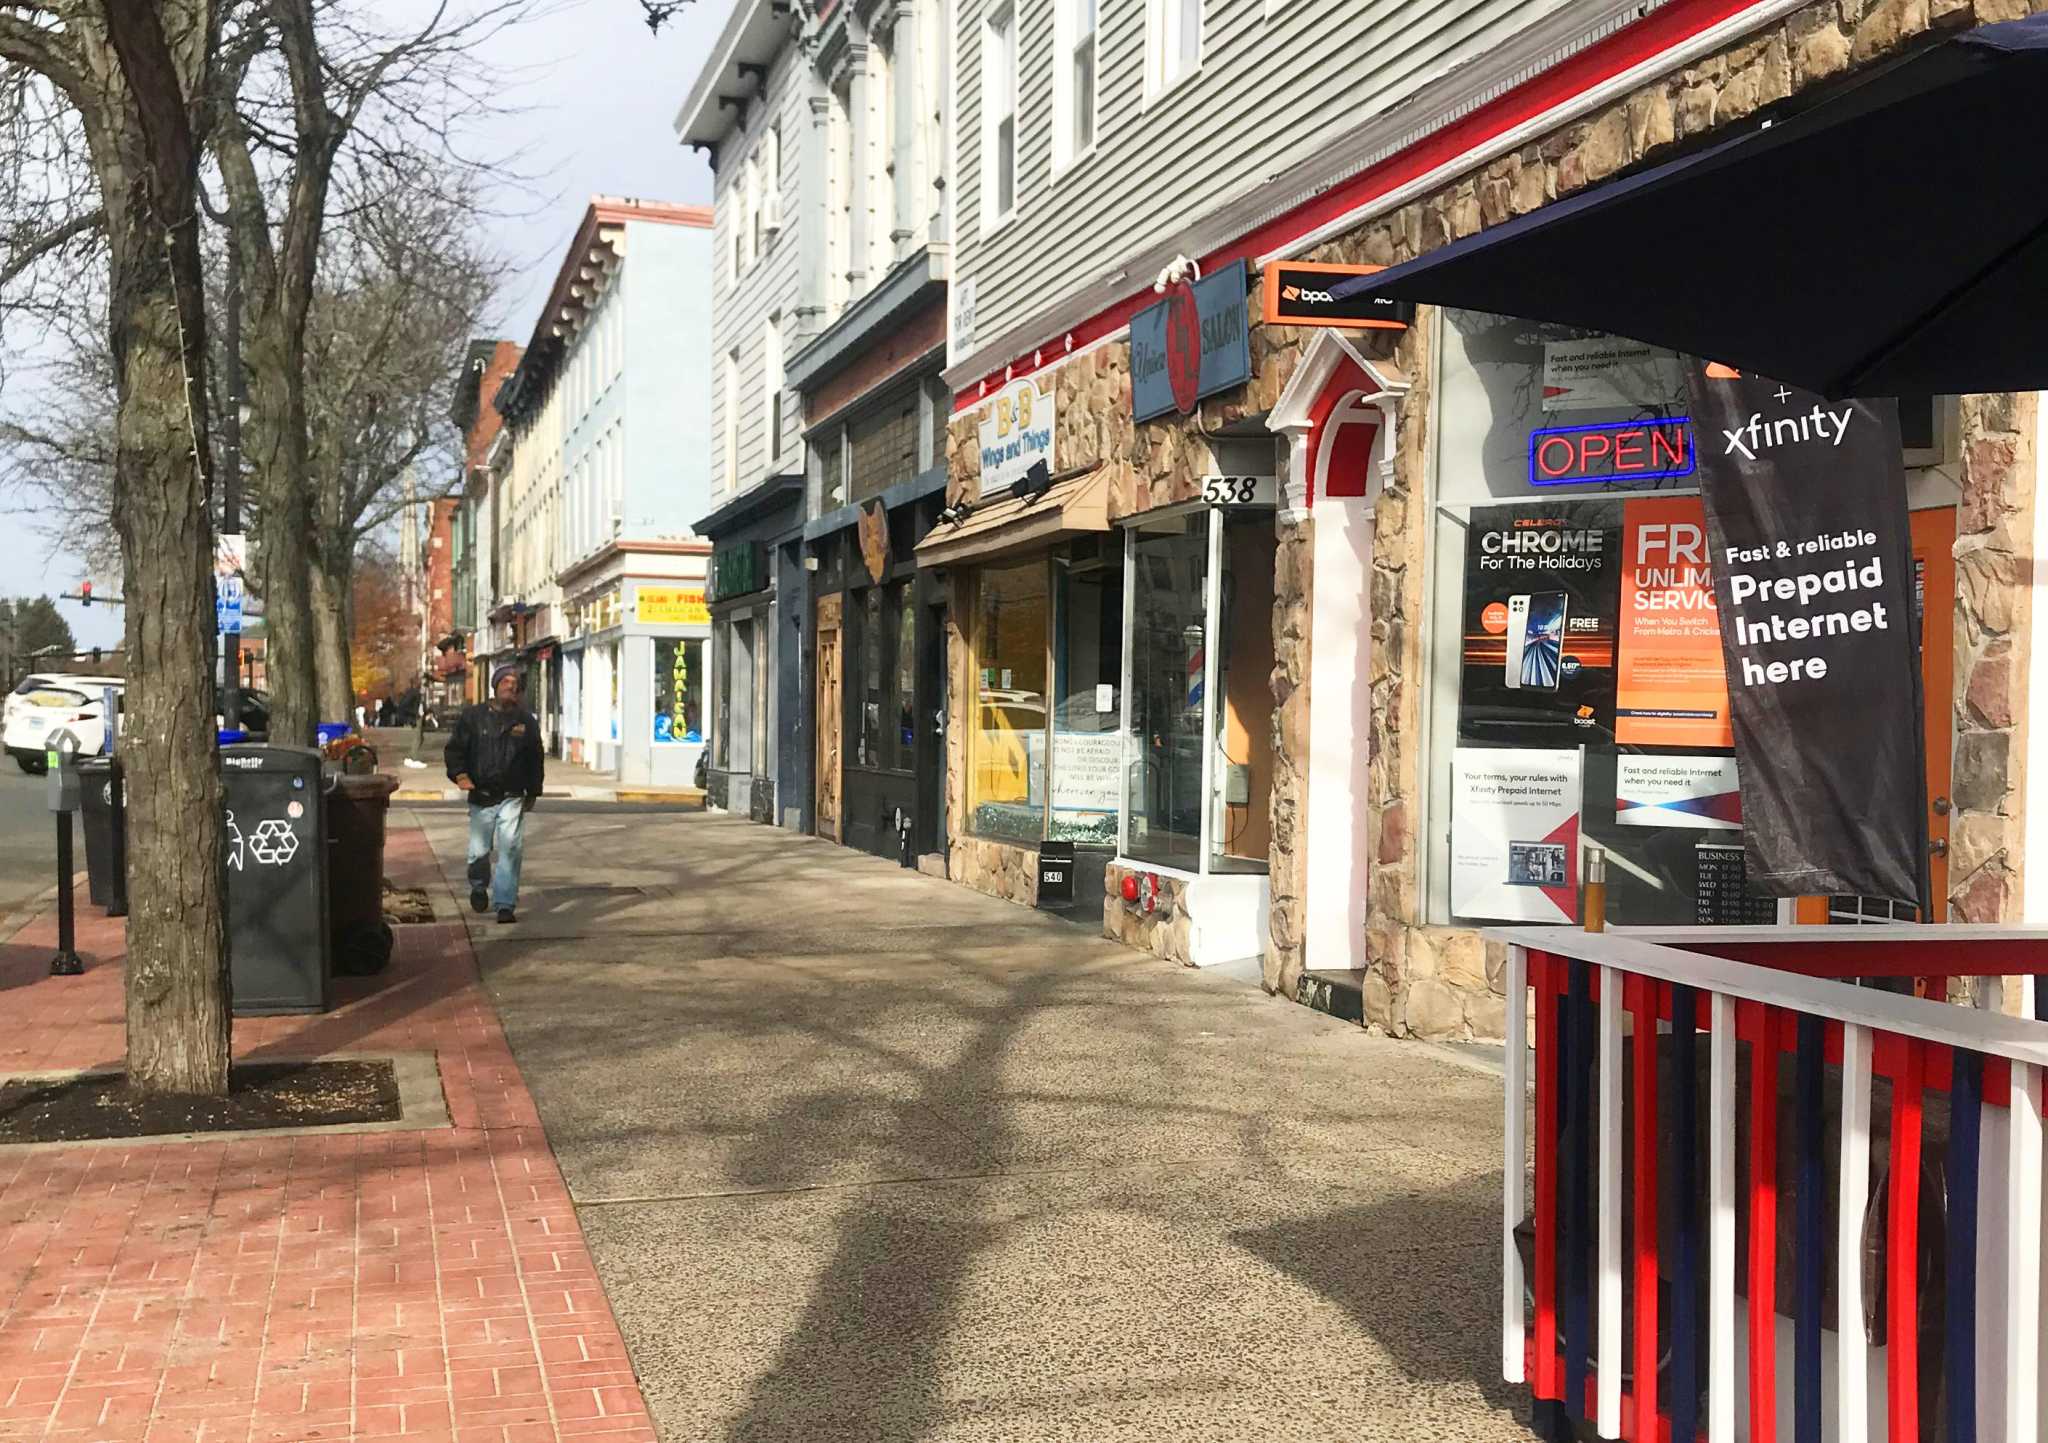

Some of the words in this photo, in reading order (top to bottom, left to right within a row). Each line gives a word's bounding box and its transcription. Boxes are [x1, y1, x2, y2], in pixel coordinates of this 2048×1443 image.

[1202, 304, 1241, 355] SALON
[1550, 355, 1568, 363] Fast
[1569, 353, 1586, 362] and
[1587, 351, 1616, 361] reliable
[1618, 349, 1651, 359] Internet
[1551, 364, 1573, 373] when
[1575, 364, 1590, 373] you
[1592, 362, 1611, 370] need
[1612, 361, 1619, 369] it
[1723, 404, 1853, 460] xfinity
[982, 447, 1005, 469] Wings
[1006, 440, 1021, 460] and
[1022, 429, 1050, 454] Things
[1538, 428, 1683, 477] OPEN
[1203, 477, 1257, 503] 538
[1481, 530, 1603, 554] CHROME
[1637, 523, 1711, 565] FR
[1726, 545, 1771, 564] Fast
[1776, 541, 1791, 558] &
[1797, 530, 1877, 555] reliable
[1480, 556, 1504, 570] For
[1507, 555, 1536, 569] The
[1539, 555, 1602, 572] Holidays
[1635, 567, 1715, 588] UNLIM
[1730, 557, 1884, 605] Prepaid
[1633, 590, 1717, 611] SERVIC
[1569, 618, 1599, 629] FREE
[1633, 627, 1656, 636] From
[1657, 626, 1681, 636] Metro
[1692, 627, 1721, 636] Cricke
[1634, 617, 1659, 626] When
[1661, 617, 1678, 626] You
[1679, 616, 1708, 626] Switch
[1735, 602, 1888, 646] Internet
[1741, 656, 1828, 687] here
[673, 640, 688, 737] JAMAICAN
[1574, 717, 1596, 725] boost
[1464, 773, 1481, 781] Your
[1483, 773, 1508, 782] terms,
[1509, 775, 1528, 783] your
[1529, 773, 1548, 782] rules
[1549, 774, 1568, 783] with
[1624, 777, 1645, 785] when
[1642, 767, 1658, 775] and
[1659, 767, 1688, 776] reliable
[1690, 768, 1722, 777] Internet
[1470, 785, 1496, 795] Xfinity
[1497, 786, 1528, 796] Prepaid
[1529, 786, 1562, 796] Internet
[1698, 851, 1740, 860] BUSINESS
[1044, 872, 1063, 883] 540
